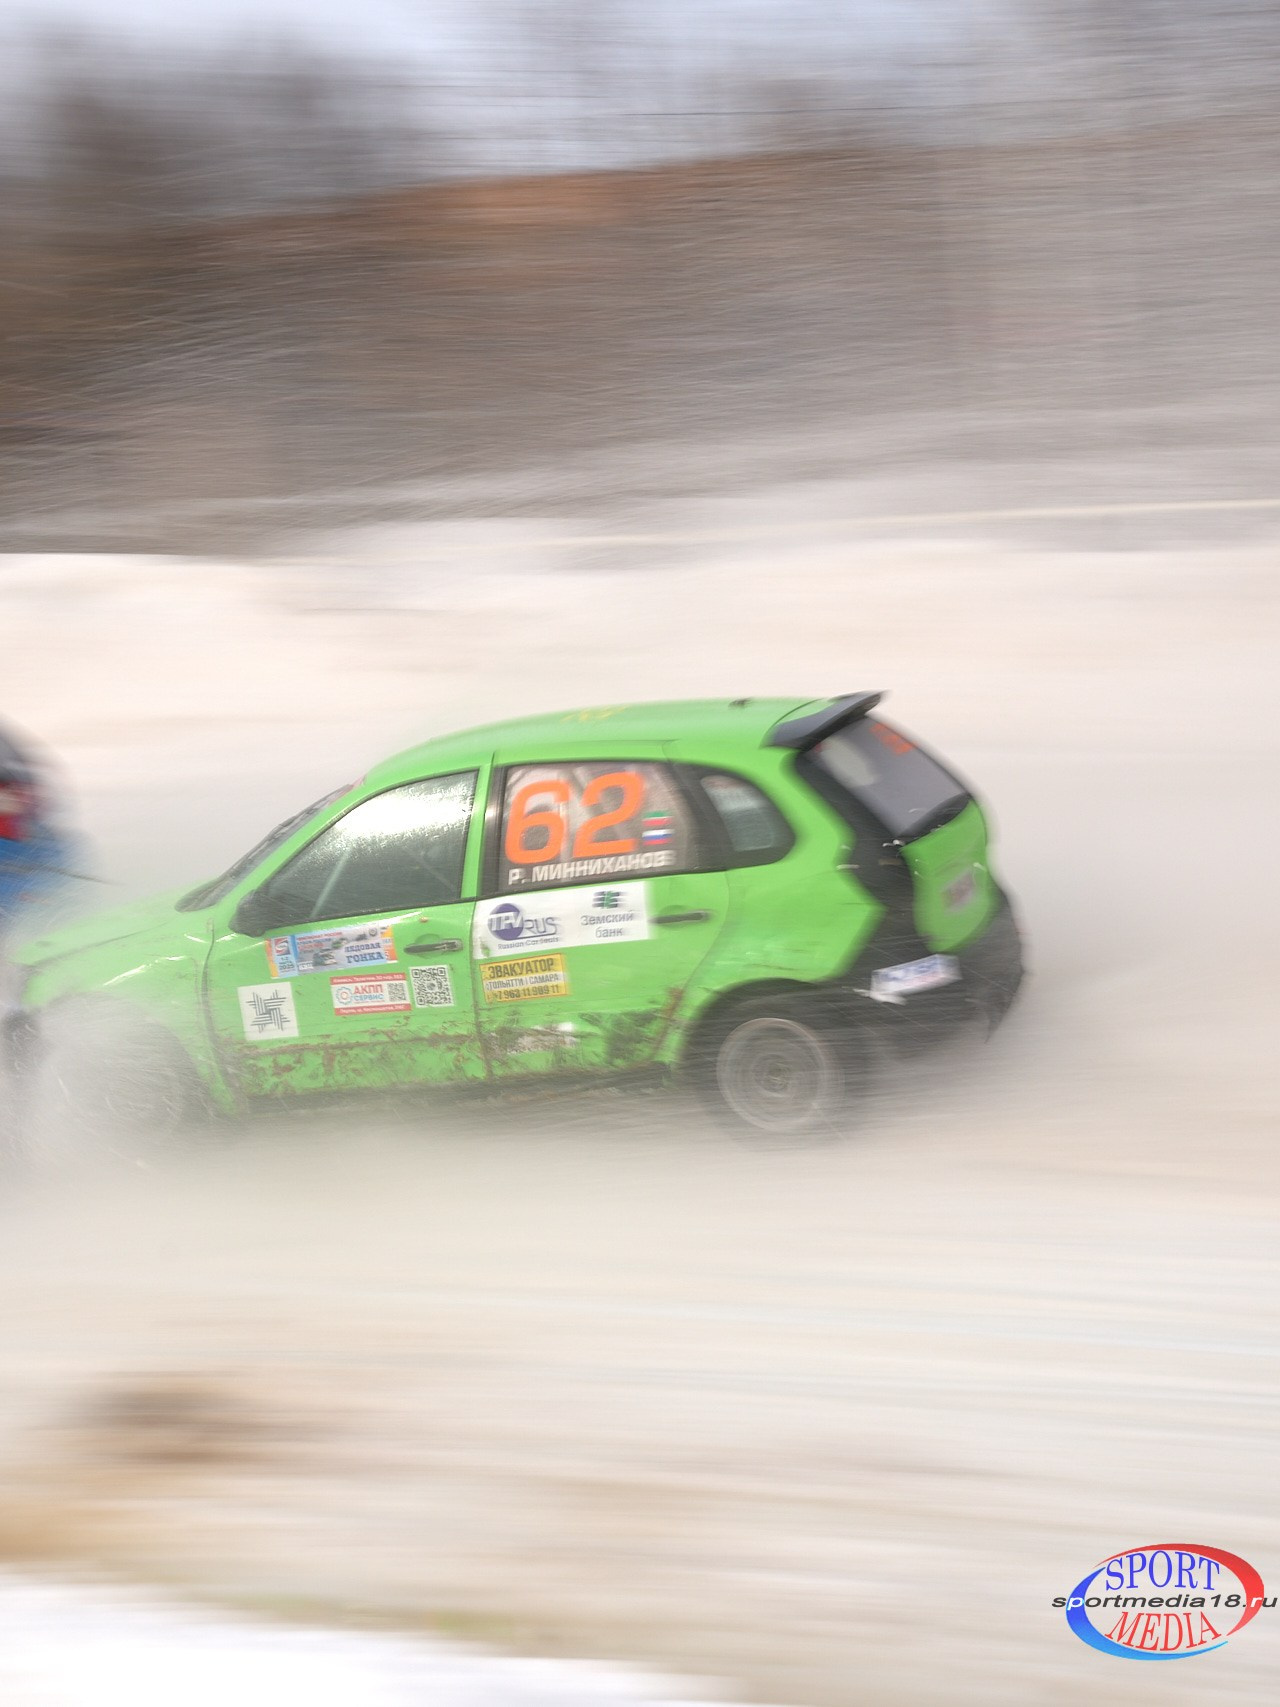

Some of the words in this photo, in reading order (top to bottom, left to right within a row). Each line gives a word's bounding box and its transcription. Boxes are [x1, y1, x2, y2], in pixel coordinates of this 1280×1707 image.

[505, 771, 644, 864] 62
[508, 868, 526, 885] Р.
[531, 850, 675, 883] МИННИХАНОВ
[581, 911, 634, 926] Земский
[595, 927, 624, 938] банк
[345, 942, 381, 953] ЛЕДОВАЯ
[346, 951, 385, 964] ГОНКА
[488, 958, 554, 978] ЭВАКУАТОР
[529, 974, 559, 986] САМАРА
[353, 984, 384, 995] АКПП
